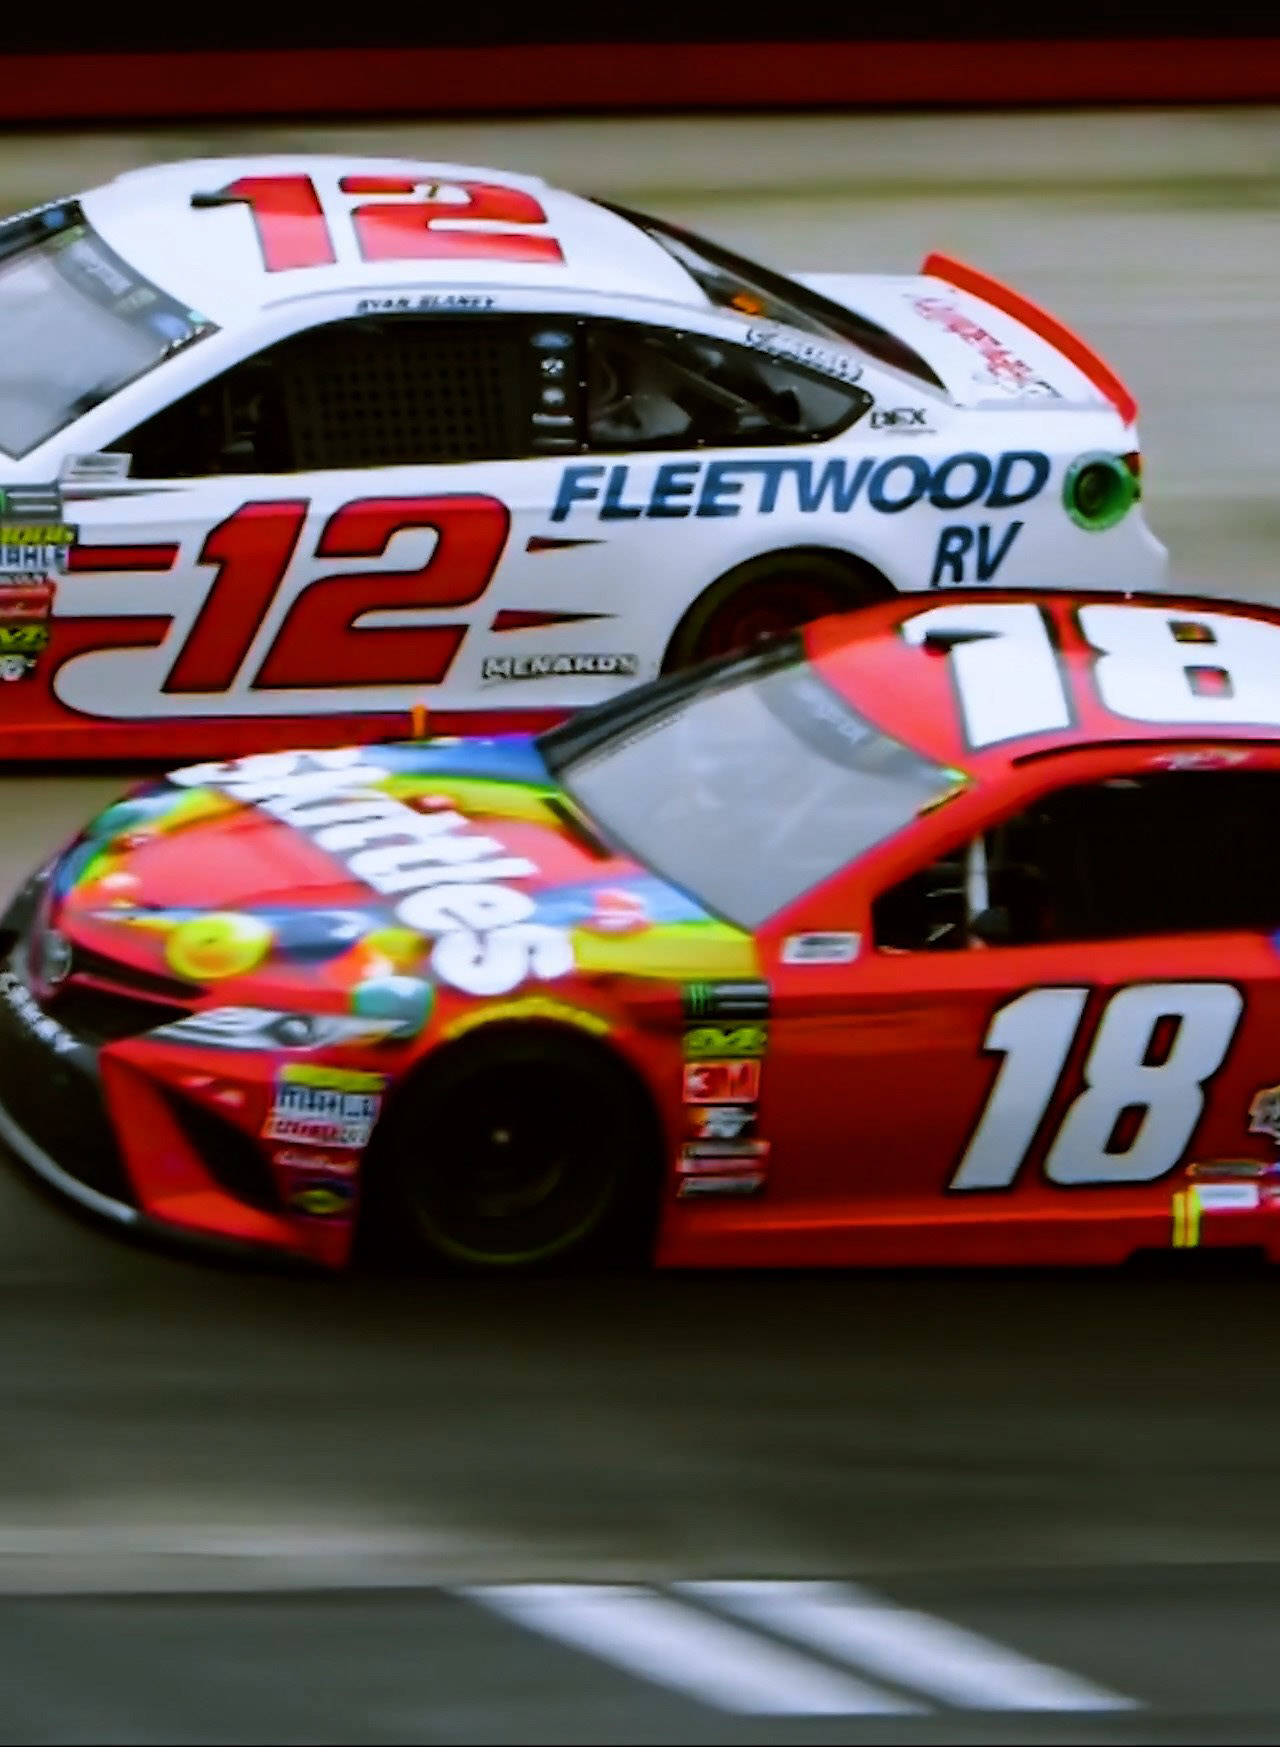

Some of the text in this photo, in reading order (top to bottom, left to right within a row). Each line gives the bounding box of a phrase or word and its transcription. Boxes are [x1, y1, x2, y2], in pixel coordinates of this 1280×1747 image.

[191, 173, 565, 272] 12
[550, 450, 1051, 522] FLEETWOOD
[931, 521, 1023, 587] RV
[160, 492, 511, 693] 12
[164, 745, 575, 996] Skittles
[944, 980, 1246, 1193] 18
